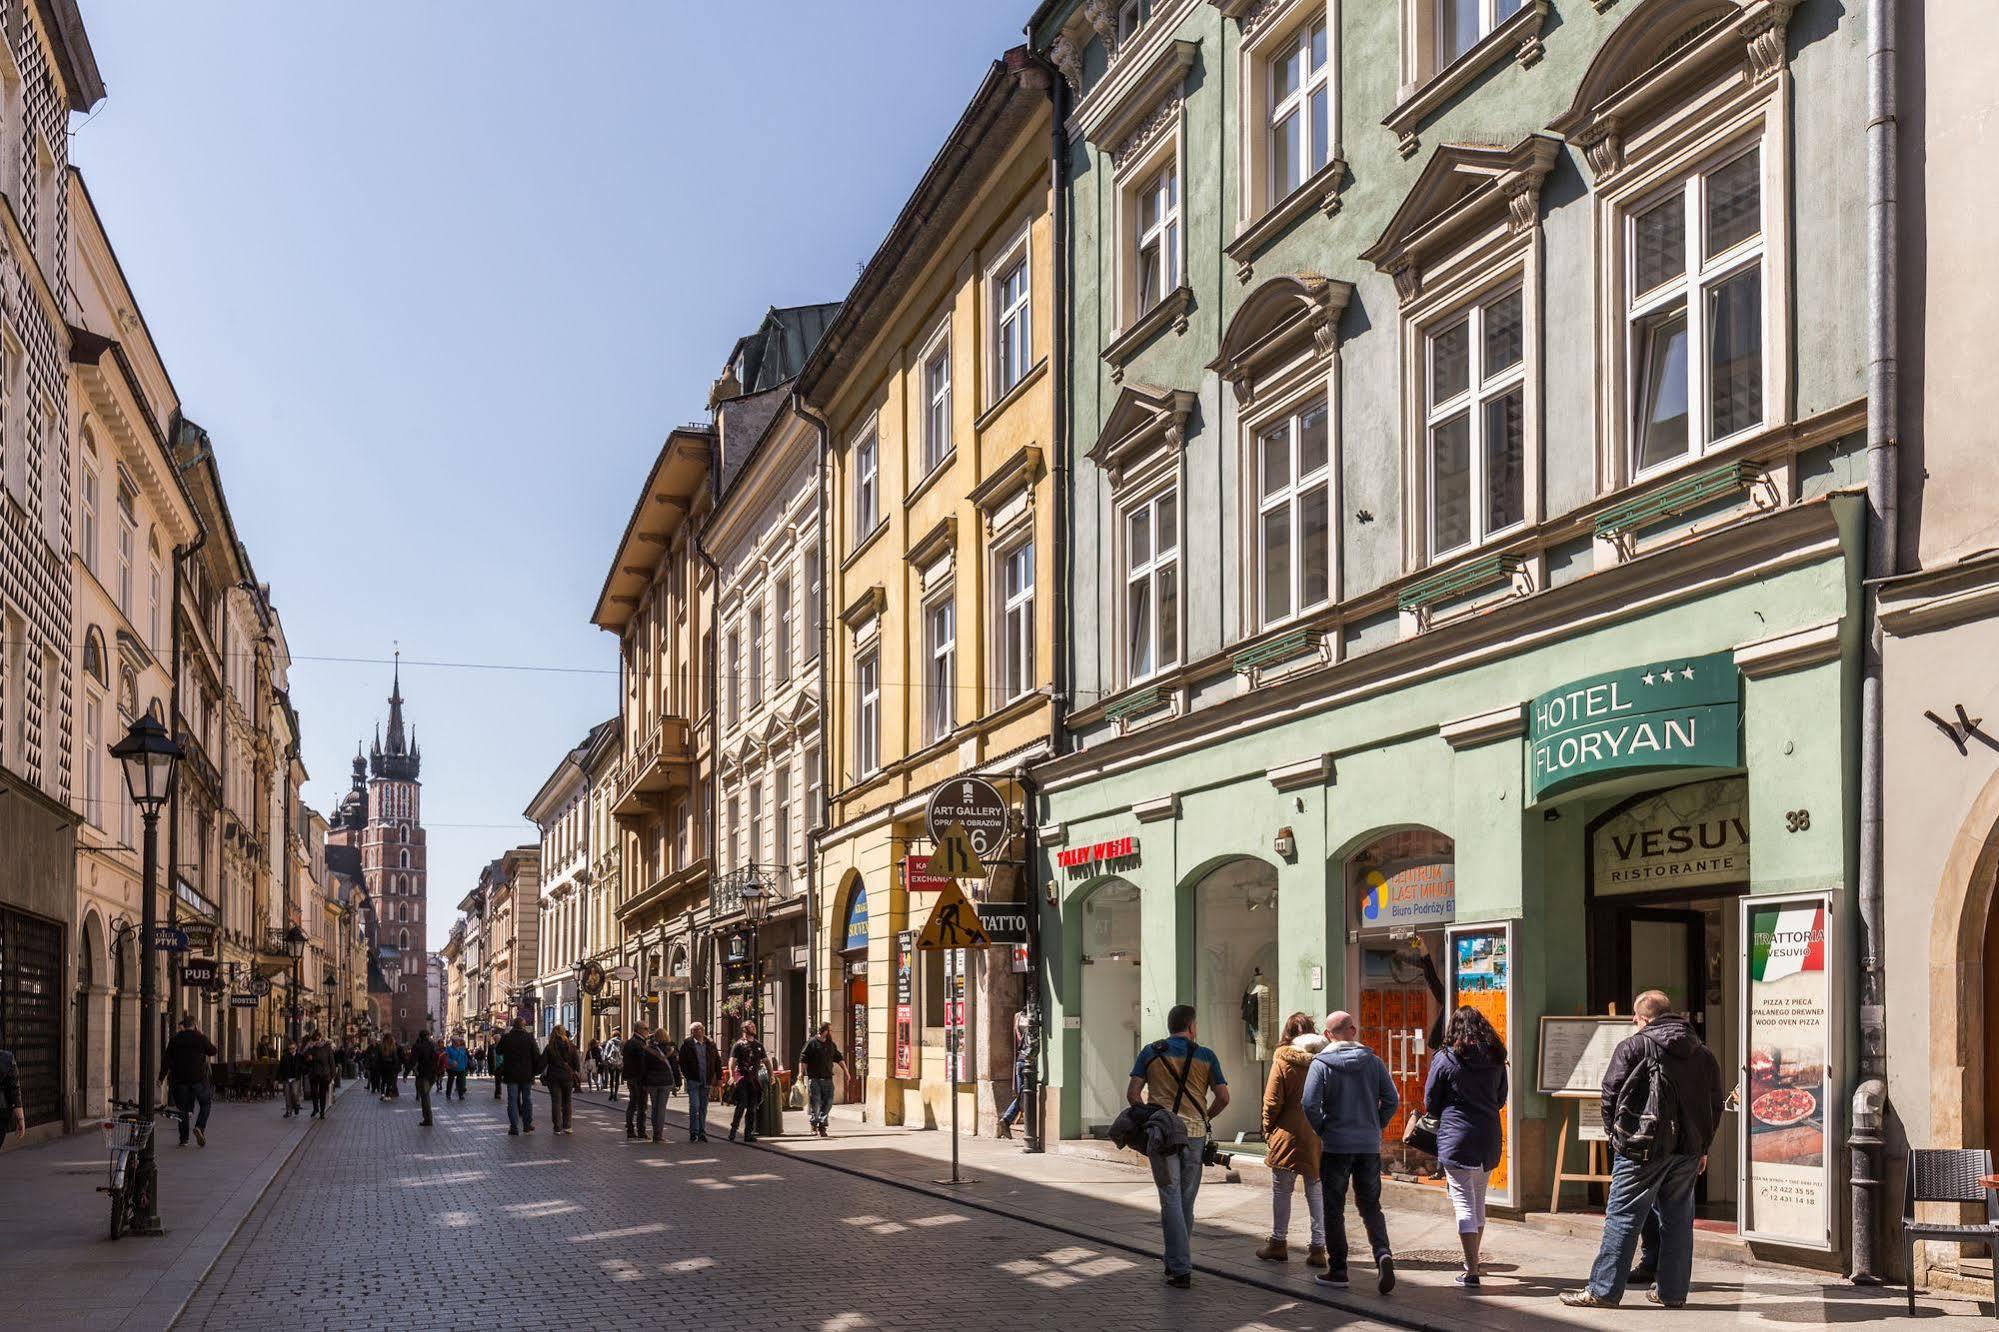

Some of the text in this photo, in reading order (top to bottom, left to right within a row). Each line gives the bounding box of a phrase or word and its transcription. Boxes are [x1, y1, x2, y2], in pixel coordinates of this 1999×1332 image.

[1535, 681, 1633, 734] HOTEL
[1535, 717, 1696, 778] FLORYAN
[933, 806, 1002, 816] ART GALLERY
[966, 818, 1002, 826] OBRAZÓW
[1786, 808, 1811, 833] 38
[1611, 857, 1734, 881] RISTORANTE
[1391, 884, 1419, 903] LAST
[1392, 905, 1412, 917] Biuro
[1413, 900, 1444, 916] Podróży
[1754, 929, 1824, 945] TRATTORIA
[1768, 948, 1811, 957] VESUVIO
[184, 969, 211, 980] PUB
[1791, 998, 1812, 1006] PIECA
[1755, 1018, 1820, 1026] WOOD OVEN PIZZA
[1795, 1196, 1803, 1204] 14
